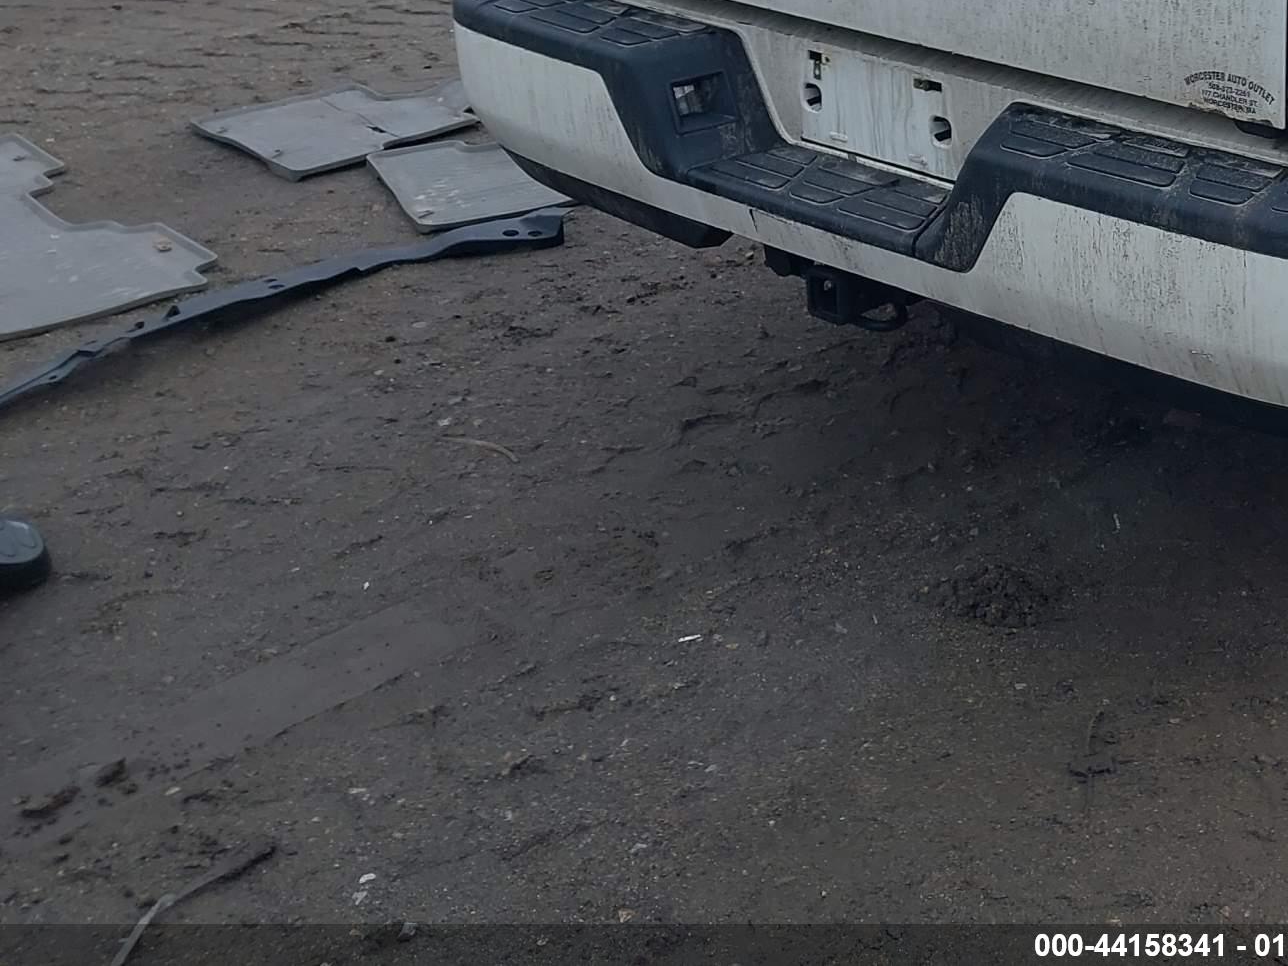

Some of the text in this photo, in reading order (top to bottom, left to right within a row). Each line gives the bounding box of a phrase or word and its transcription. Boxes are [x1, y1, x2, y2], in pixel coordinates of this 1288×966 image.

[1183, 70, 1275, 105] WORCESTER AUTO OUTLET
[1213, 91, 1248, 106] CHANDLER
